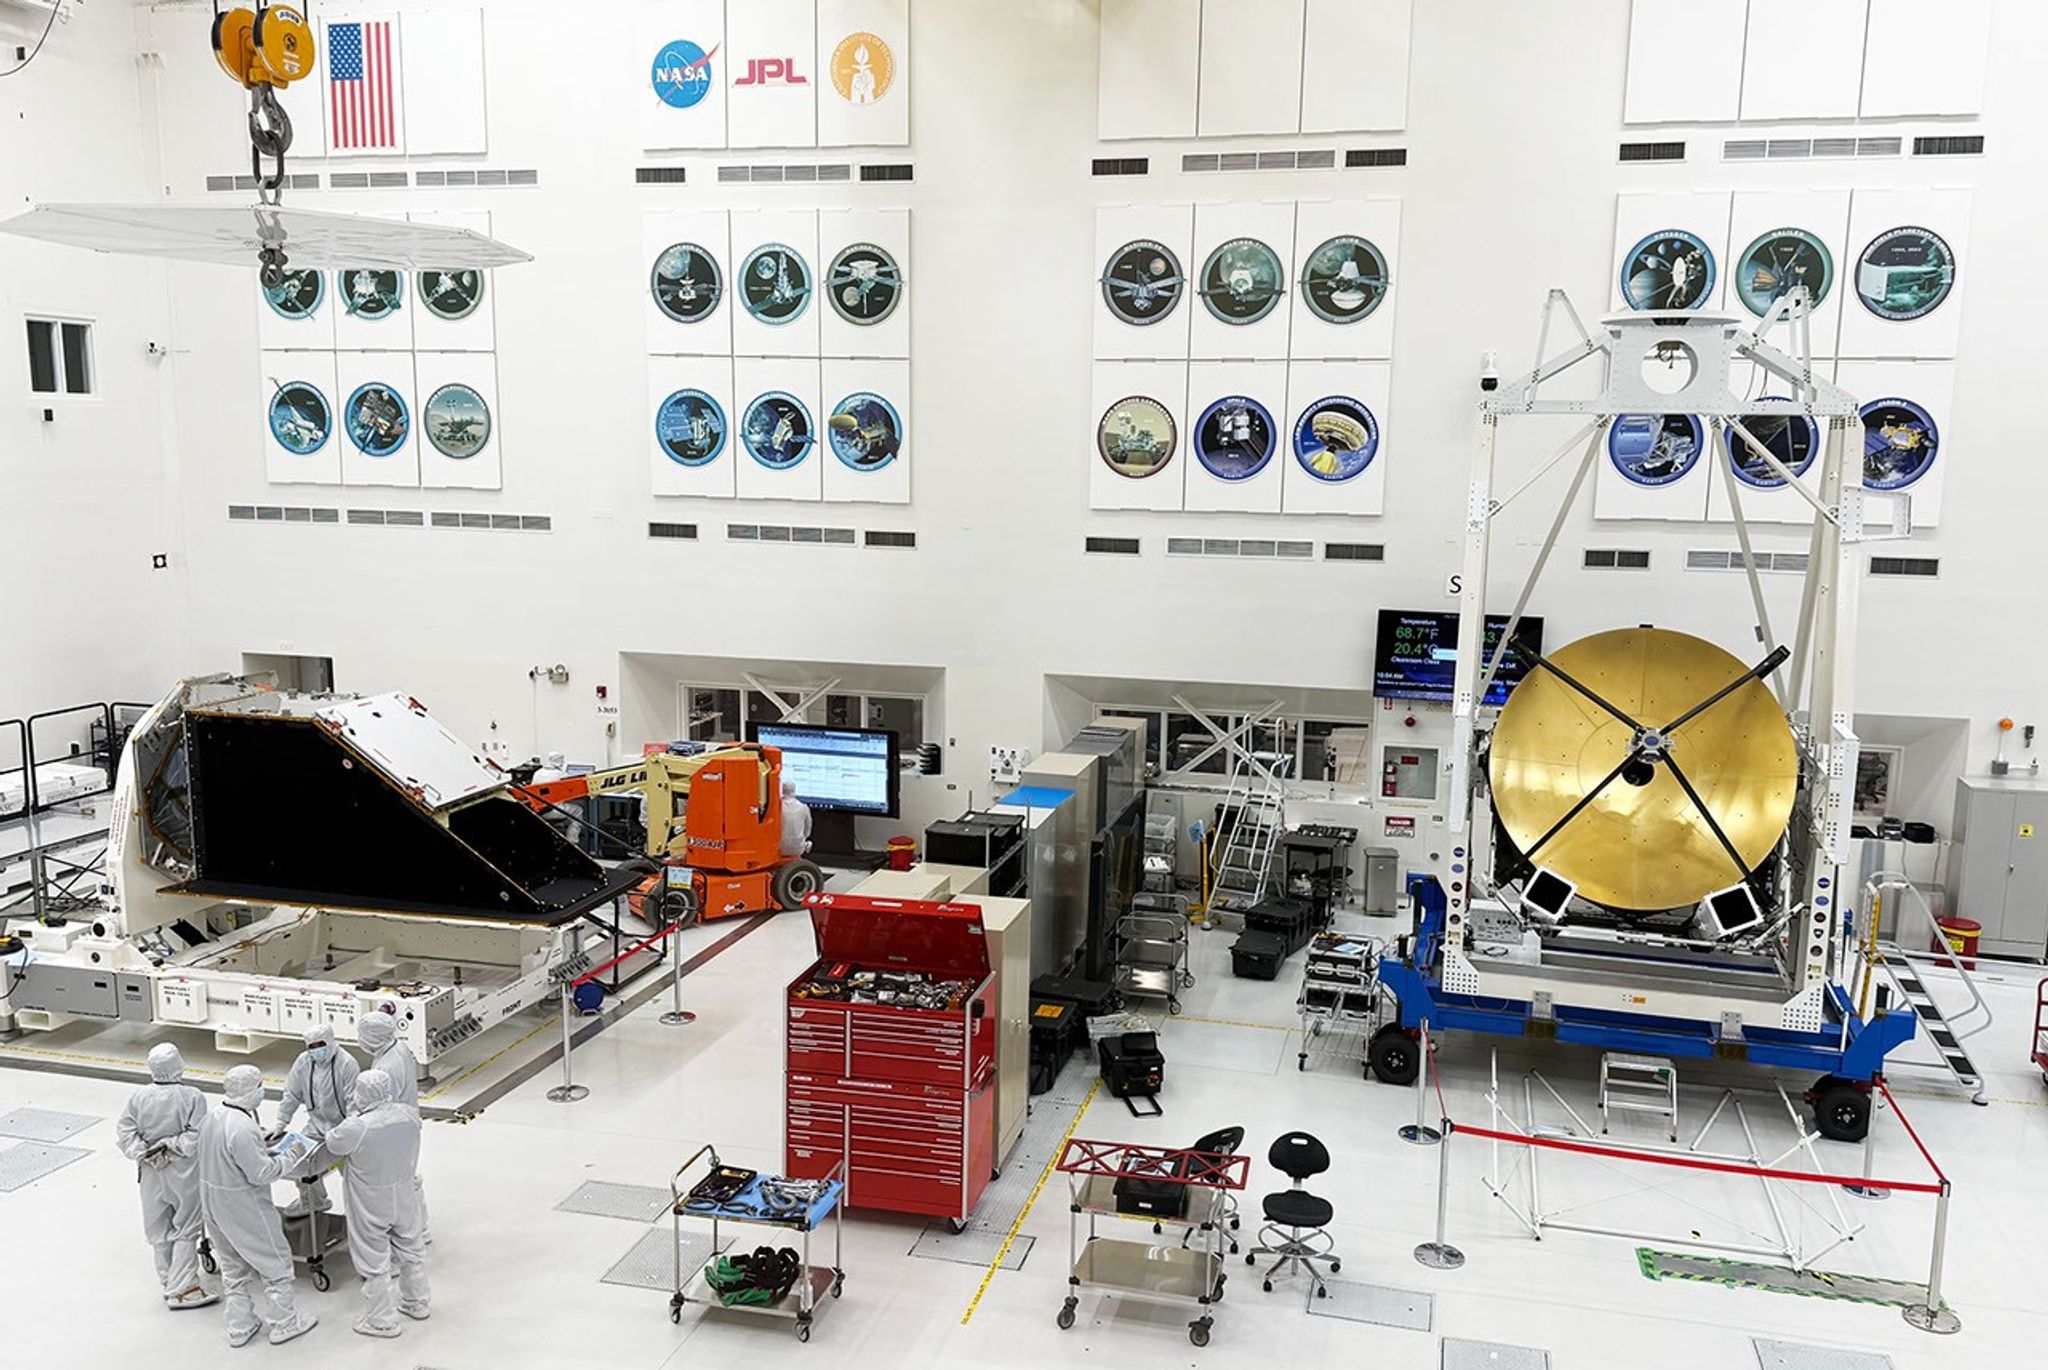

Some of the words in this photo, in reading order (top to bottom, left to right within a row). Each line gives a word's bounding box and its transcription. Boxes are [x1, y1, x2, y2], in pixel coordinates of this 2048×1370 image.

[655, 67, 709, 83] NASA
[735, 58, 807, 85] JPL
[1400, 617, 1437, 626] Temperature
[1395, 626, 1440, 640] 68.7°F
[1391, 656, 1422, 665] Cleanroom
[600, 774, 627, 789] JLG
[502, 1000, 522, 1017] FRONT
